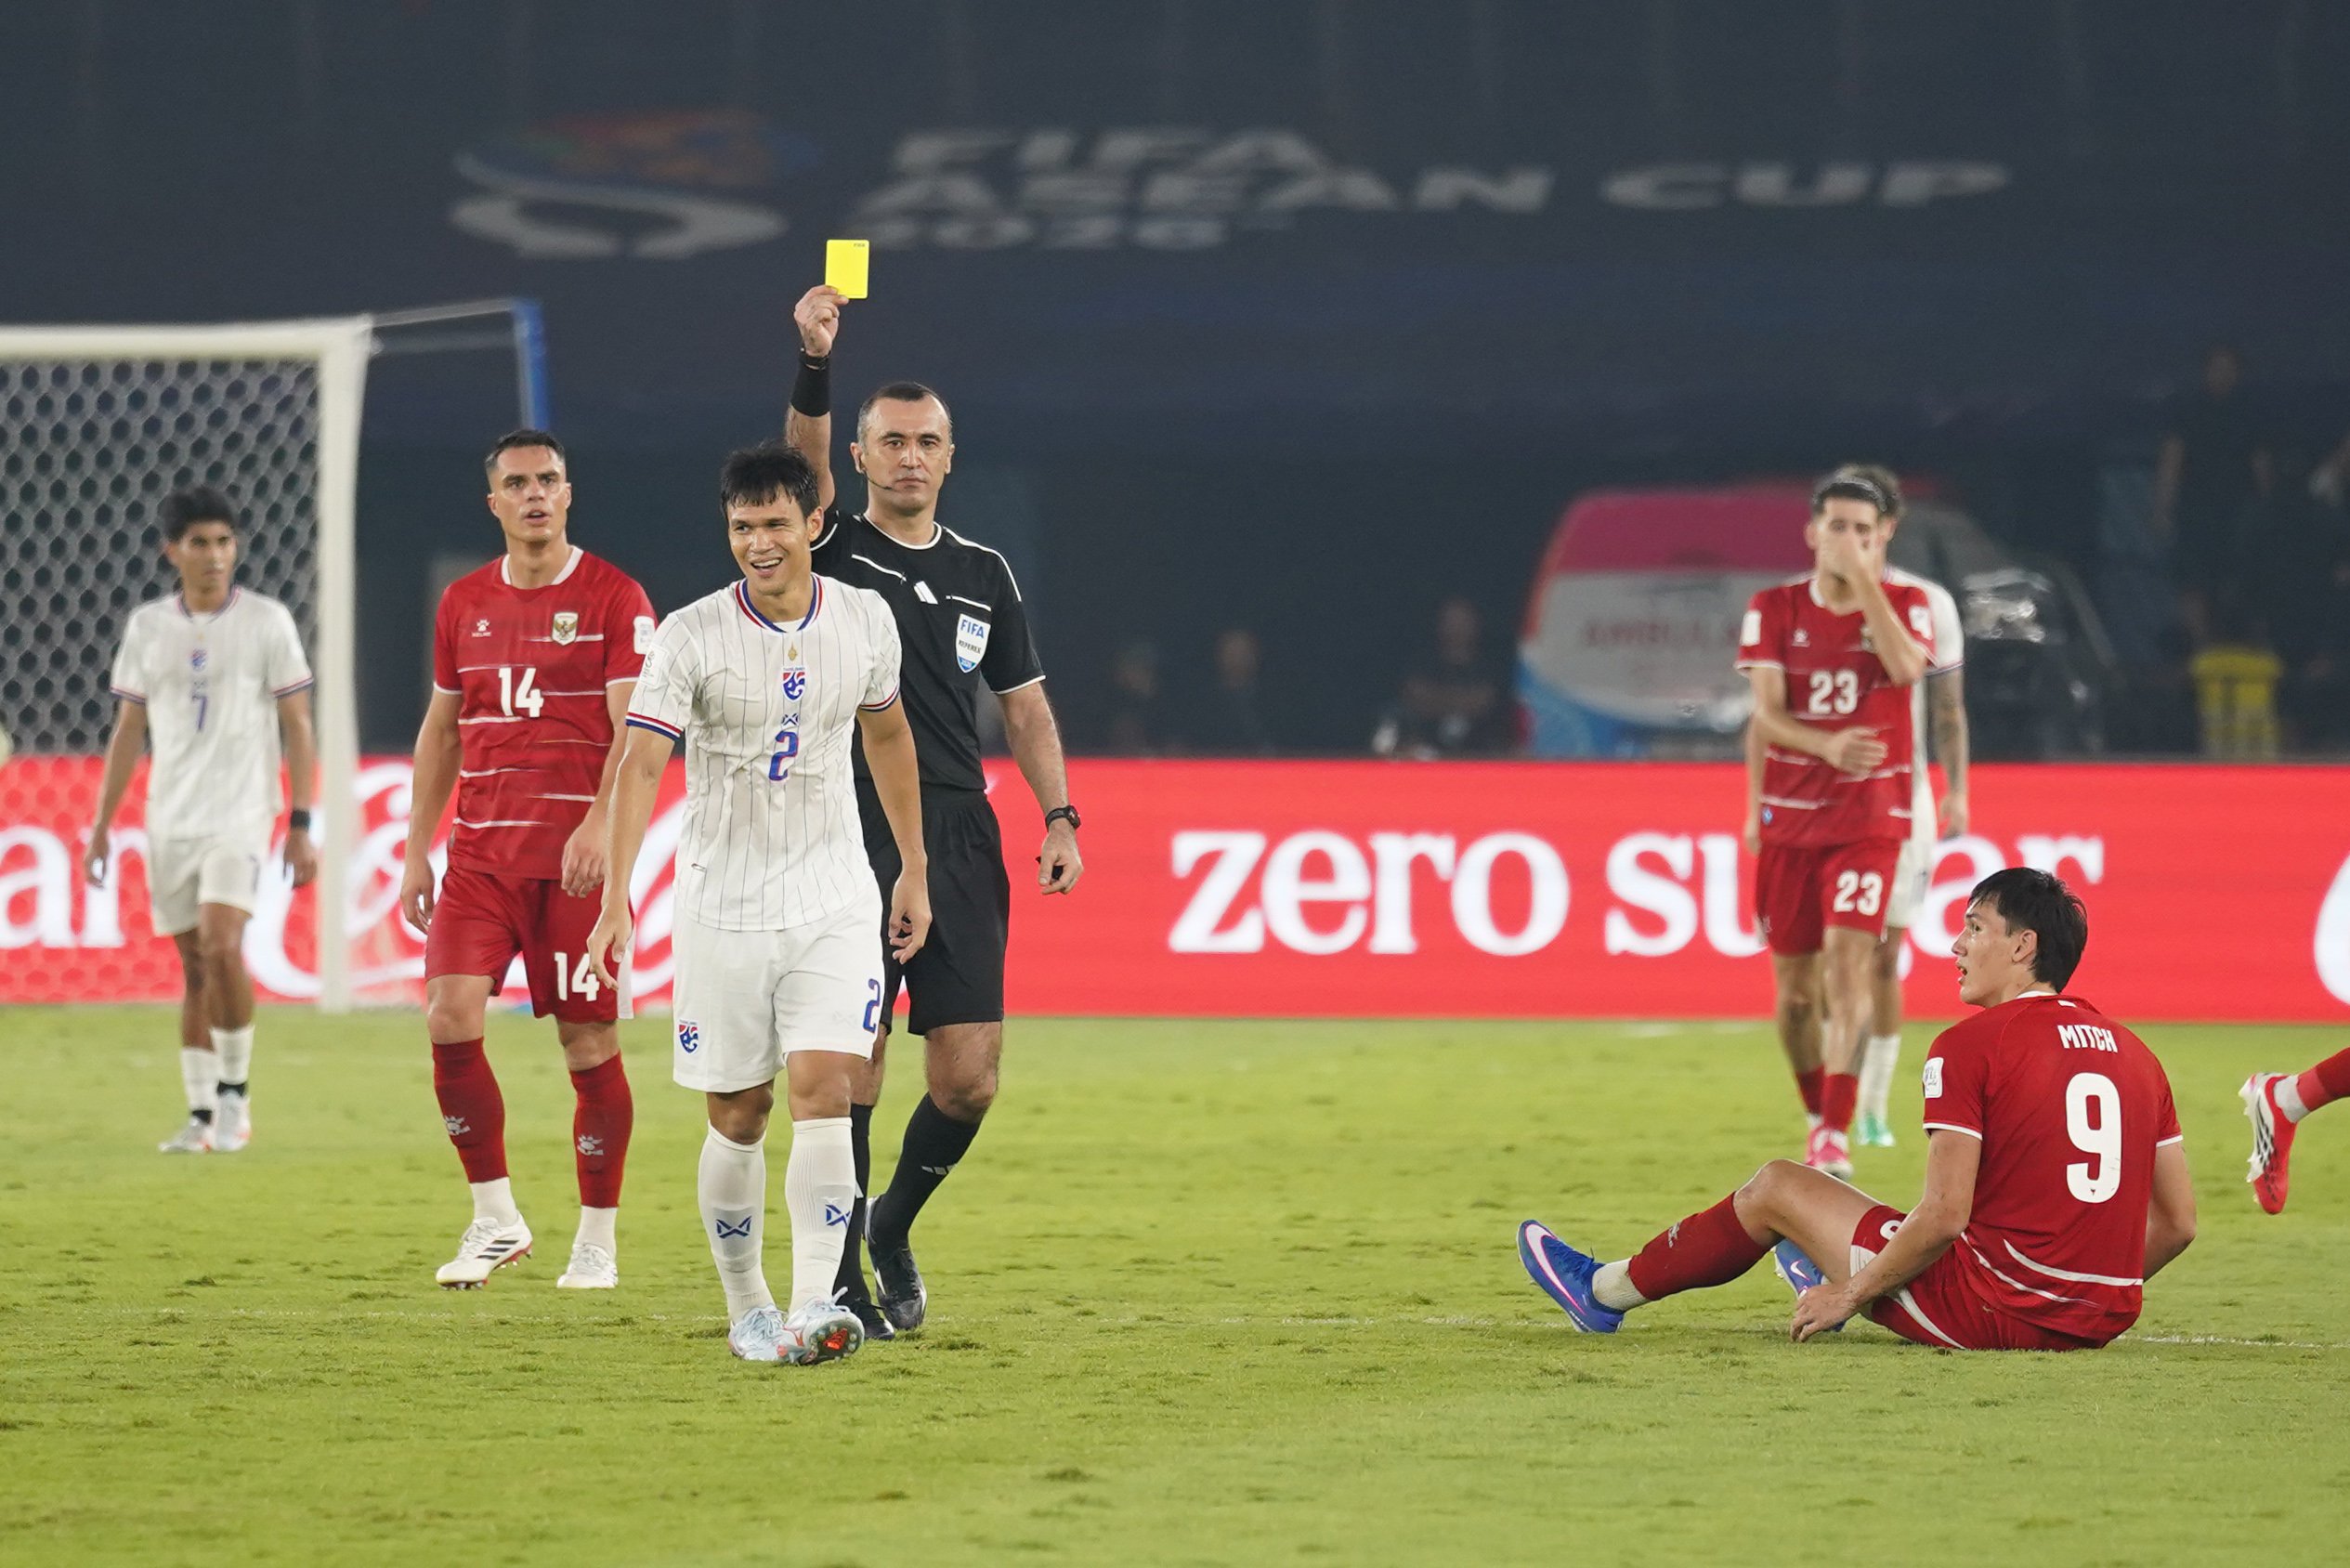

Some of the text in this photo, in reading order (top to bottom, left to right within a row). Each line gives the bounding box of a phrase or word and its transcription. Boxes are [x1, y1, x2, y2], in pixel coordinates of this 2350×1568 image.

[892, 127, 1328, 173] FIFA
[852, 162, 2008, 216] ASEAN CUP
[960, 619, 985, 639] FIFA
[191, 695, 207, 731] 7
[499, 667, 543, 718] 14
[1808, 669, 1859, 715] 23
[768, 730, 799, 781] 2
[1168, 830, 1571, 956] zero
[1833, 869, 1884, 917] 23
[554, 951, 600, 1002] 14
[863, 978, 881, 1034] 2
[2056, 1025, 2118, 1052] MITCH
[2065, 1072, 2122, 1204] 9
